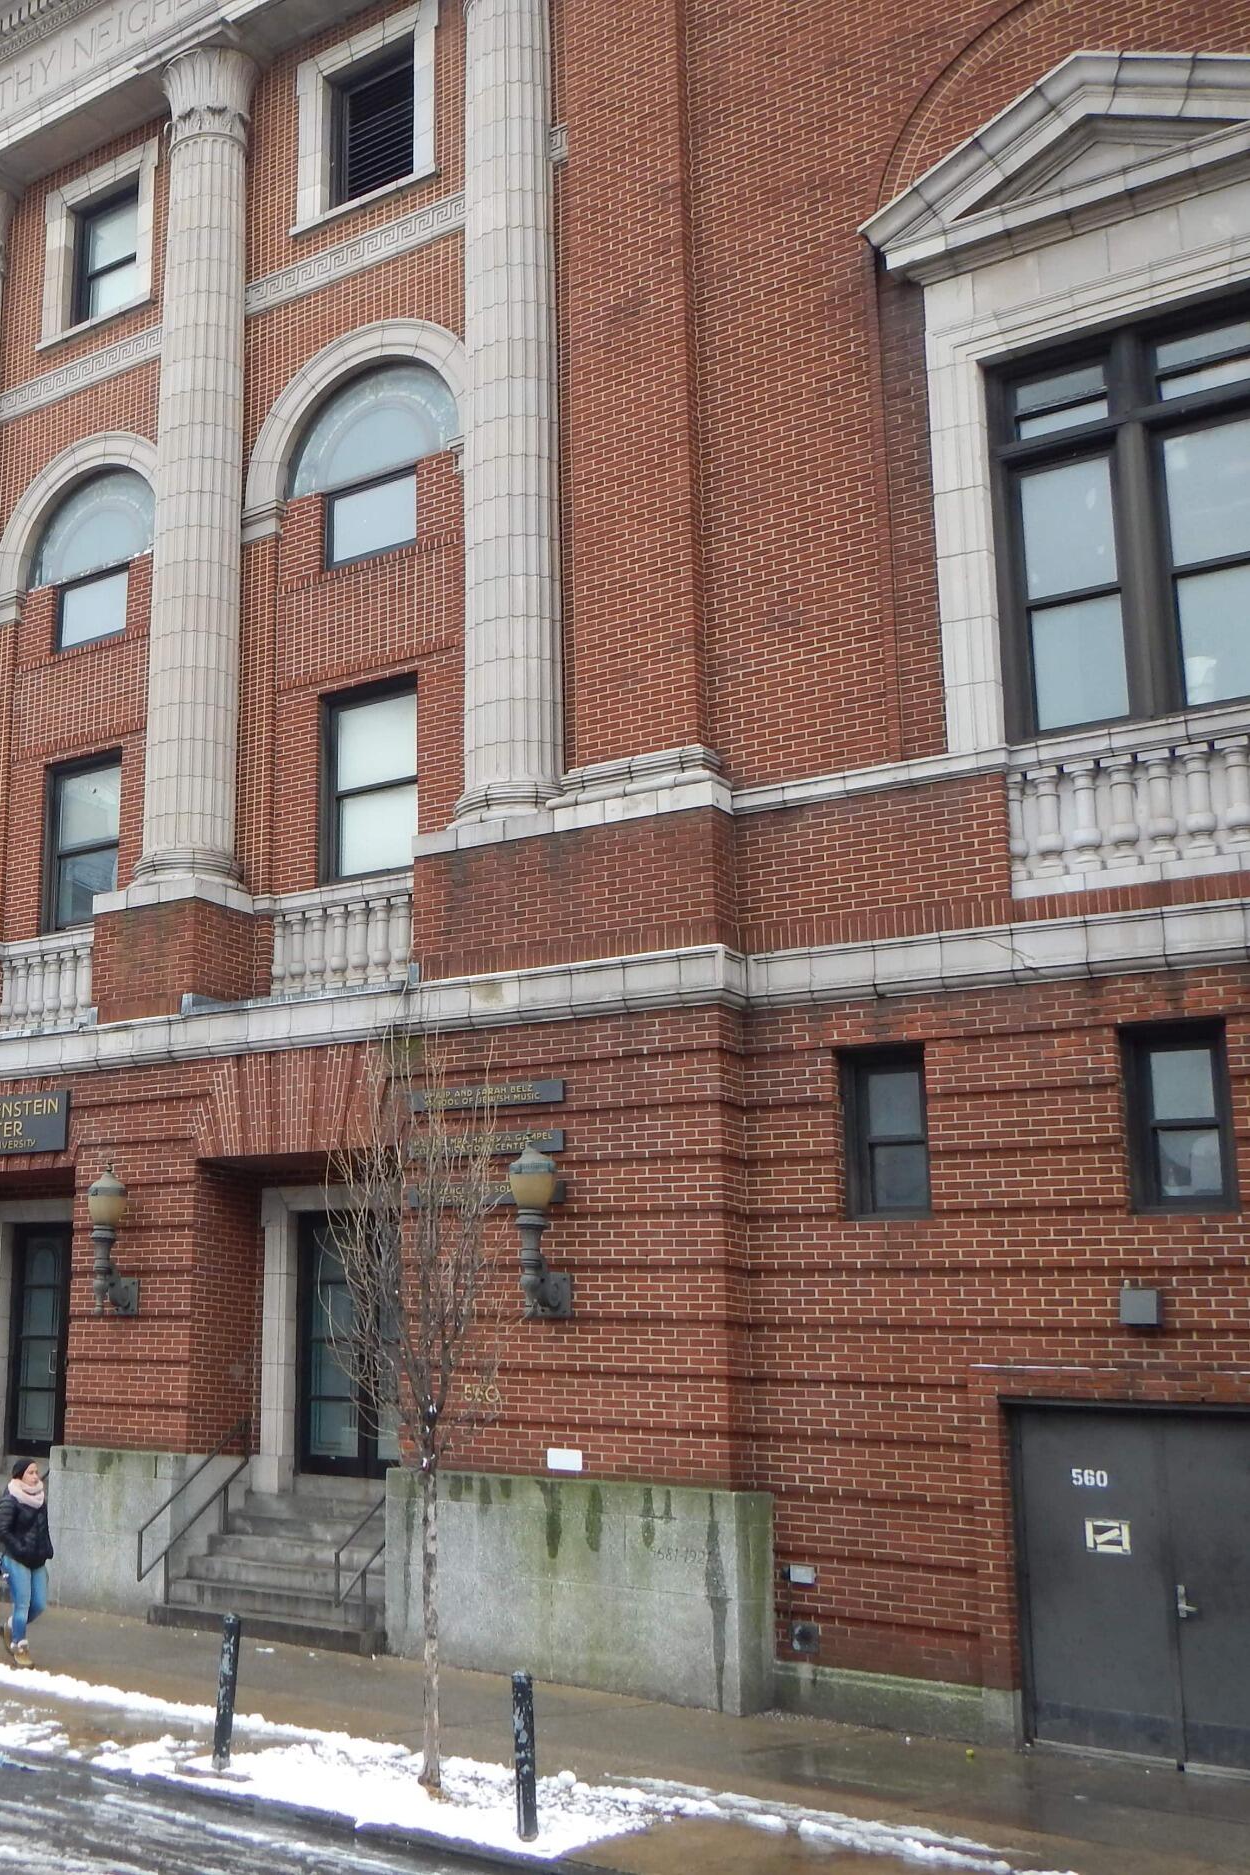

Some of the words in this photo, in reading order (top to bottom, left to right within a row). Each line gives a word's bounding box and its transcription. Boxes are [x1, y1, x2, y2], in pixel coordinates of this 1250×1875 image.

[454, 1089, 473, 1098] AND
[476, 1087, 507, 1097] SARAH
[510, 1084, 534, 1094] BELZ
[461, 1097, 474, 1105] OF
[513, 1091, 541, 1102] MUSIC
[495, 1142, 527, 1152] CENTE
[1071, 1468, 1109, 1488] 560
